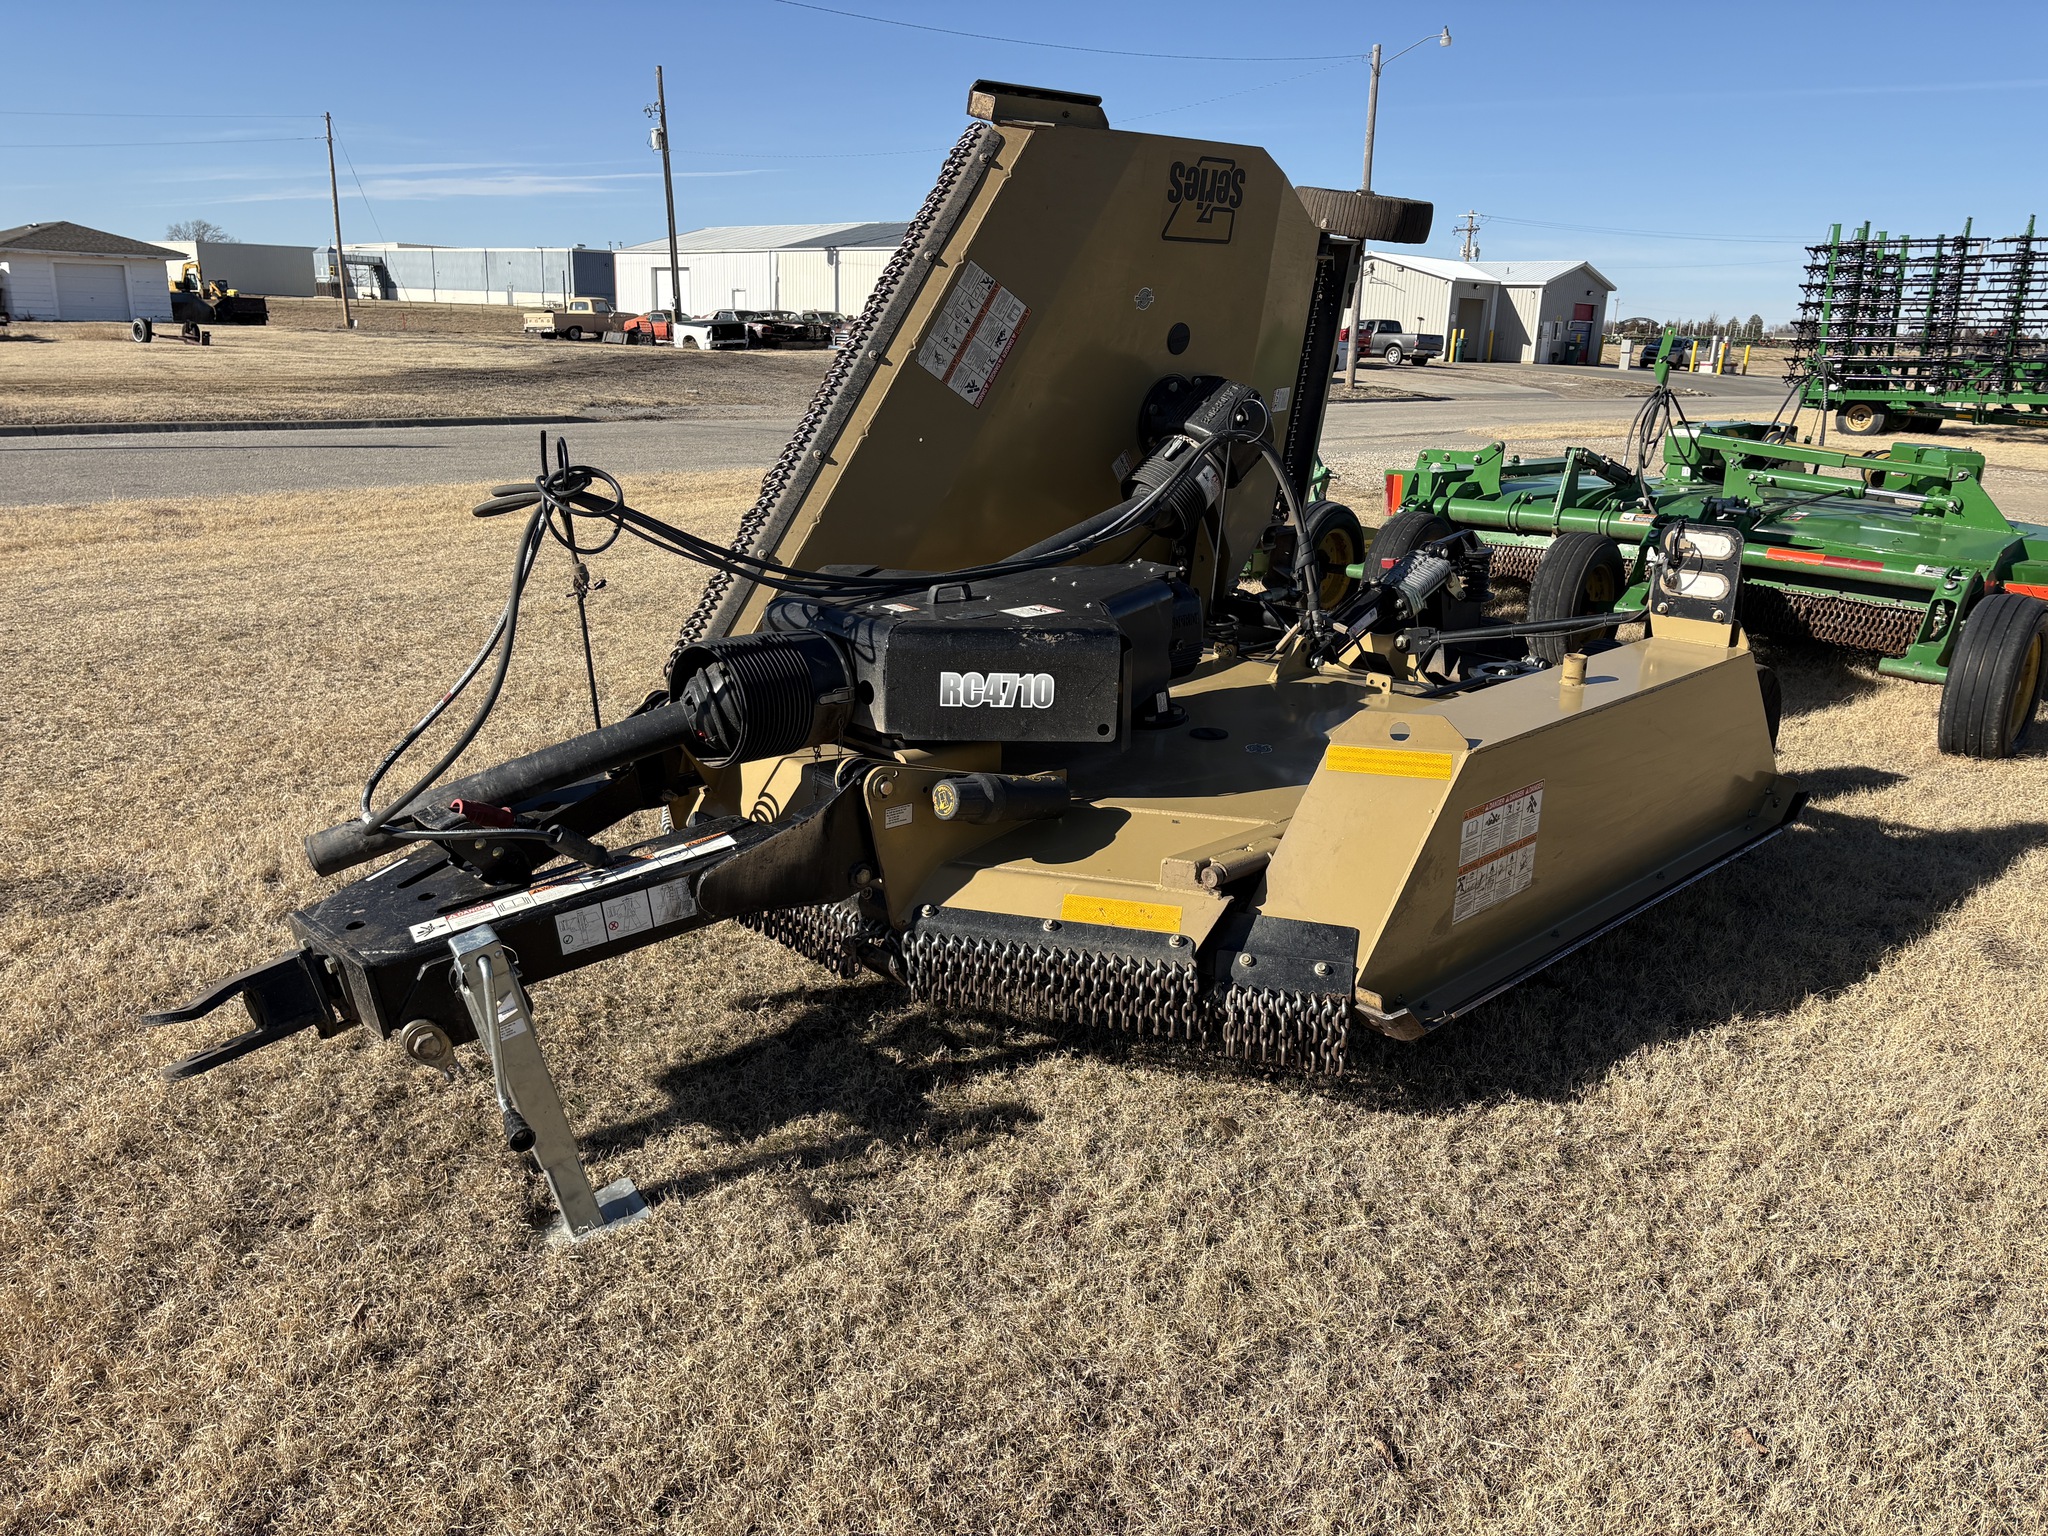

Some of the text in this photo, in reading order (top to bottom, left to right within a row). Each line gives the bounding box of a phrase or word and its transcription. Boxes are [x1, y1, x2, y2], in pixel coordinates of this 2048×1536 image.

[1001, 338, 1016, 359] DANGER
[987, 363, 1001, 384] DANGER
[973, 387, 987, 408] DANGER
[940, 672, 1055, 709] RC4710
[457, 903, 493, 916] DANGER
